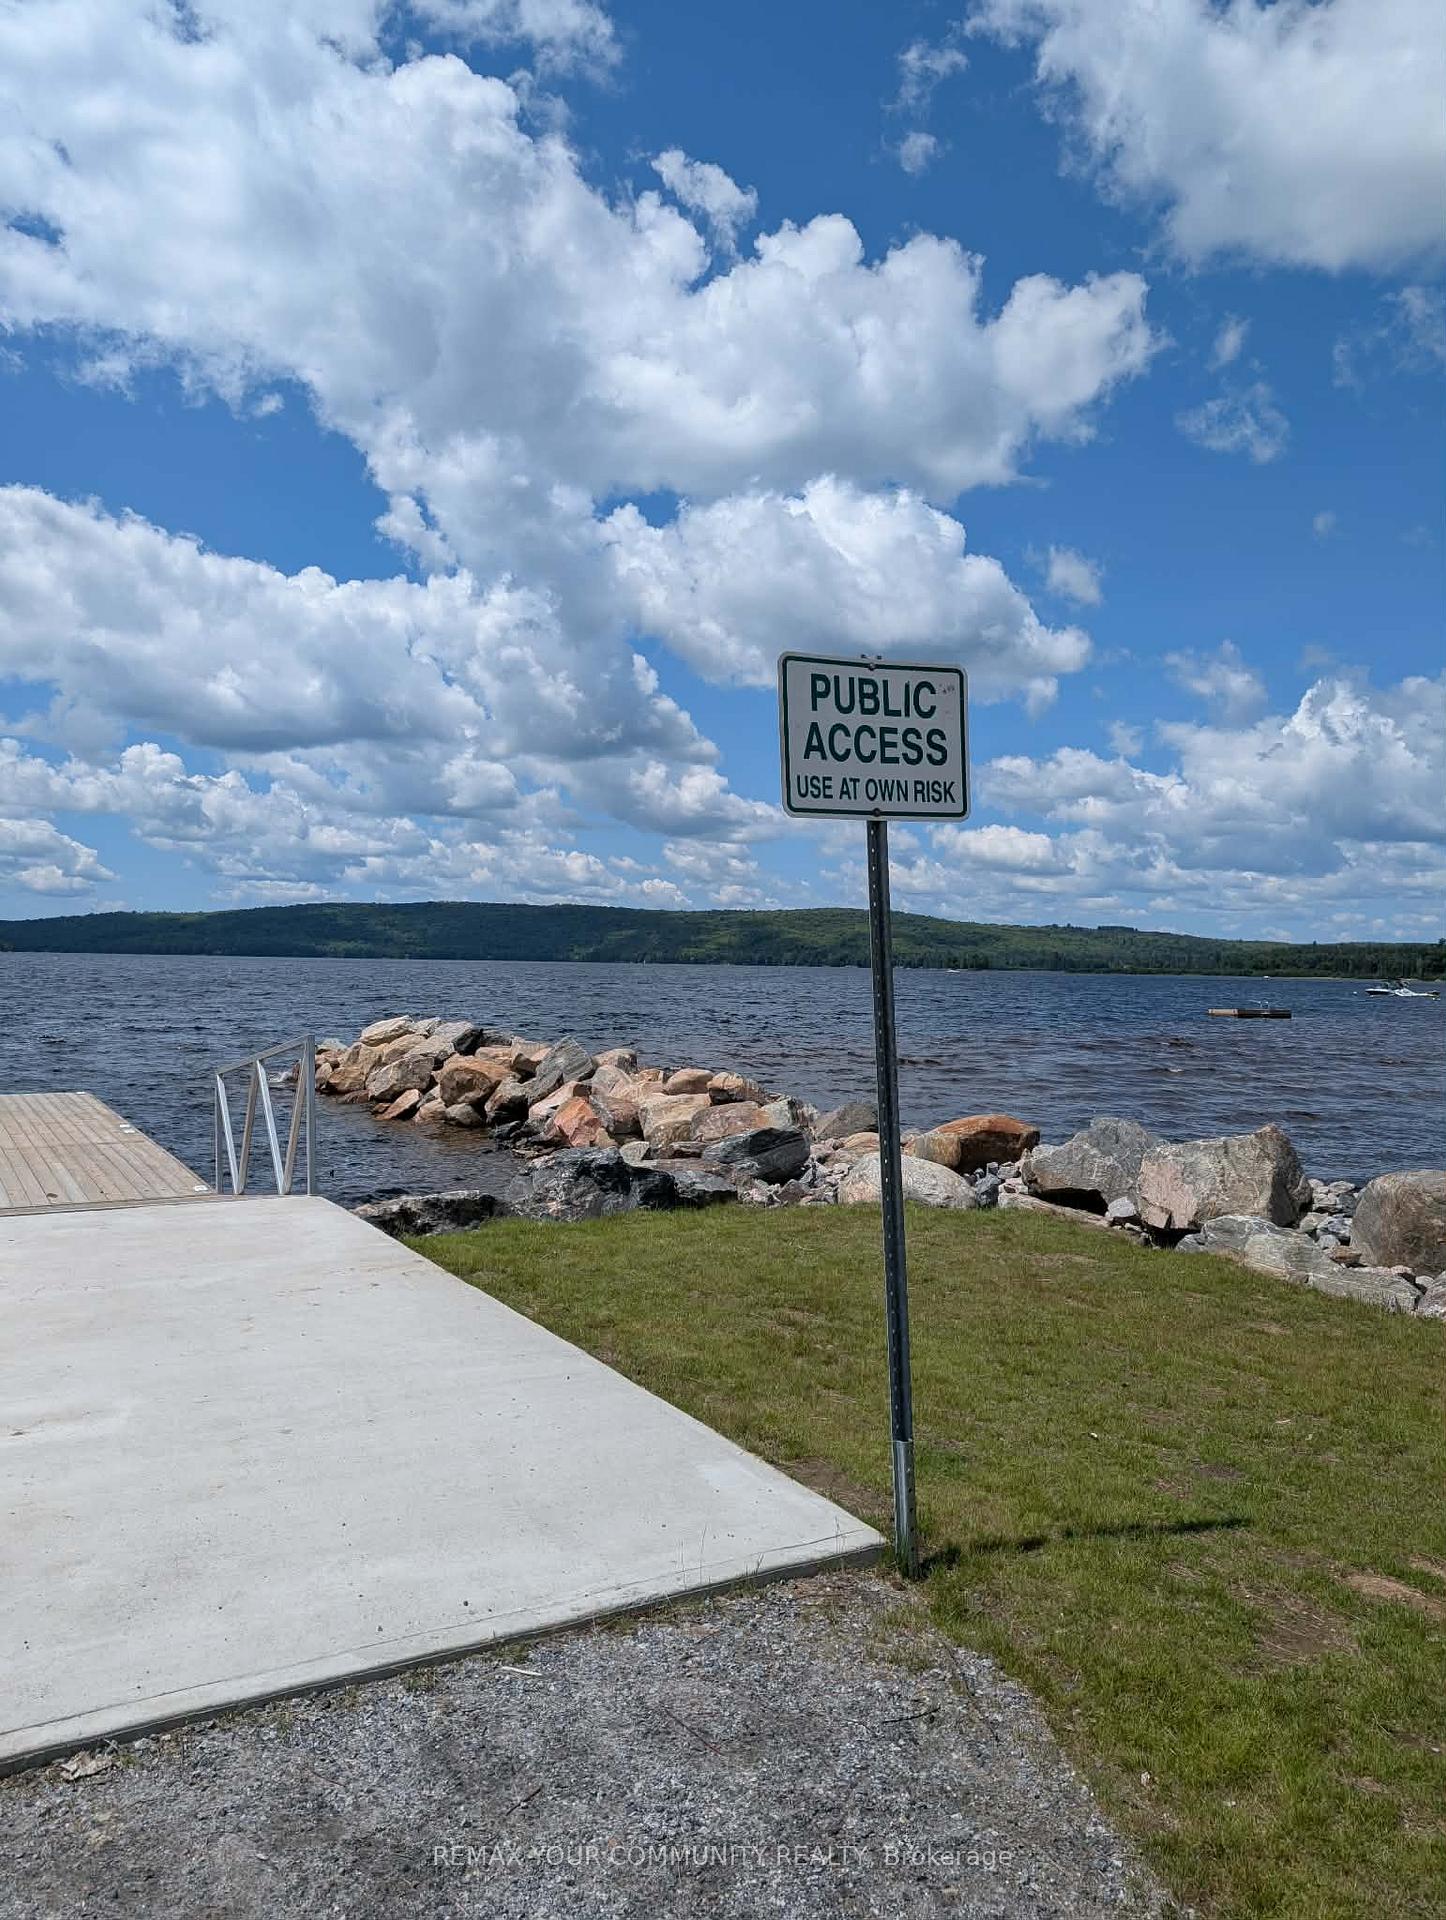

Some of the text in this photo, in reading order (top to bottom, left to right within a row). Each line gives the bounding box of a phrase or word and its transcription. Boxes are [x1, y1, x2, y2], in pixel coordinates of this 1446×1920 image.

[810, 673, 937, 719] PUBLIC
[803, 721, 948, 766] ACCESS
[796, 774, 956, 804] USE AT OWN RISK
